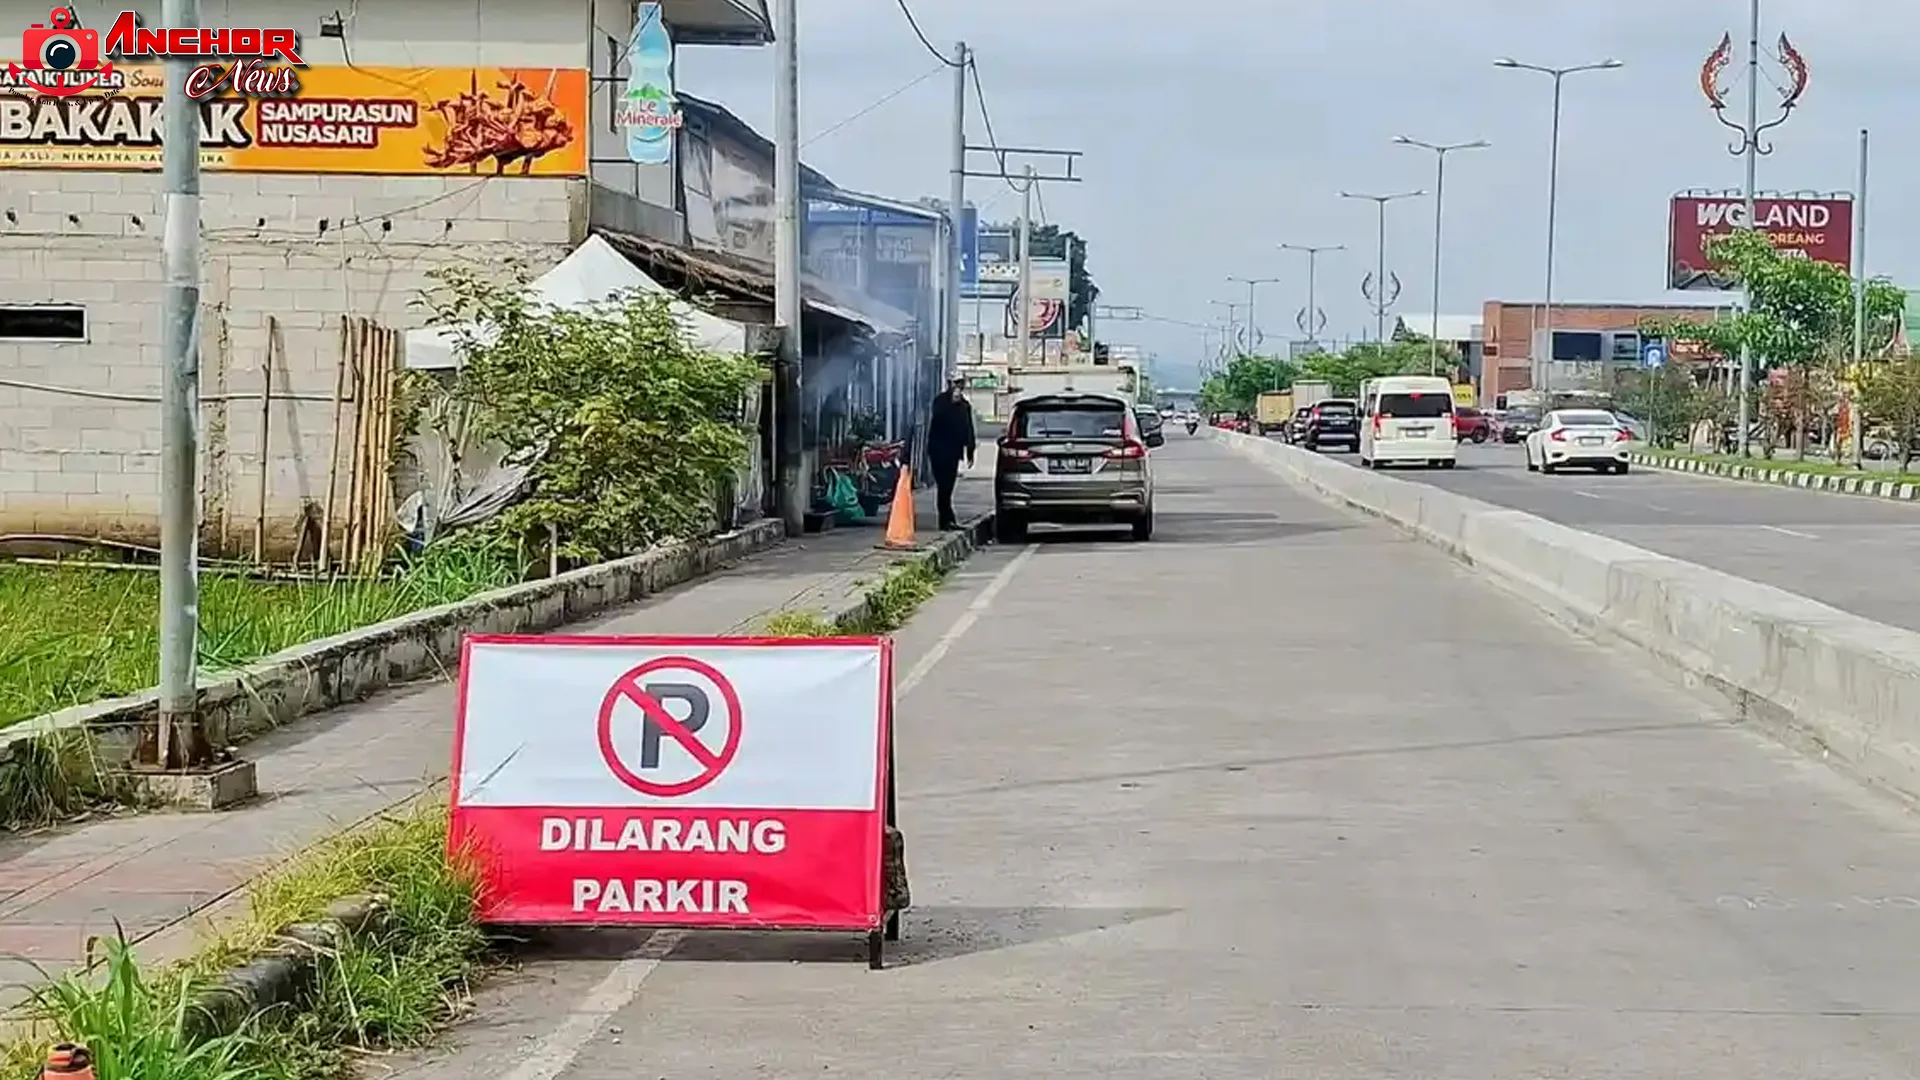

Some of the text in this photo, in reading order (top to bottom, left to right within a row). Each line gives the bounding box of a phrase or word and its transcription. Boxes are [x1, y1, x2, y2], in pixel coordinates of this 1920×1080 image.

[261, 102, 413, 122] SAMPURASUN
[639, 98, 657, 112] Le
[1, 100, 247, 143] BAKAKK
[261, 124, 373, 143] NUSASARI
[1763, 232, 1825, 245] OREANG
[540, 817, 786, 853] DILARANG
[572, 878, 750, 914] PARKIR
